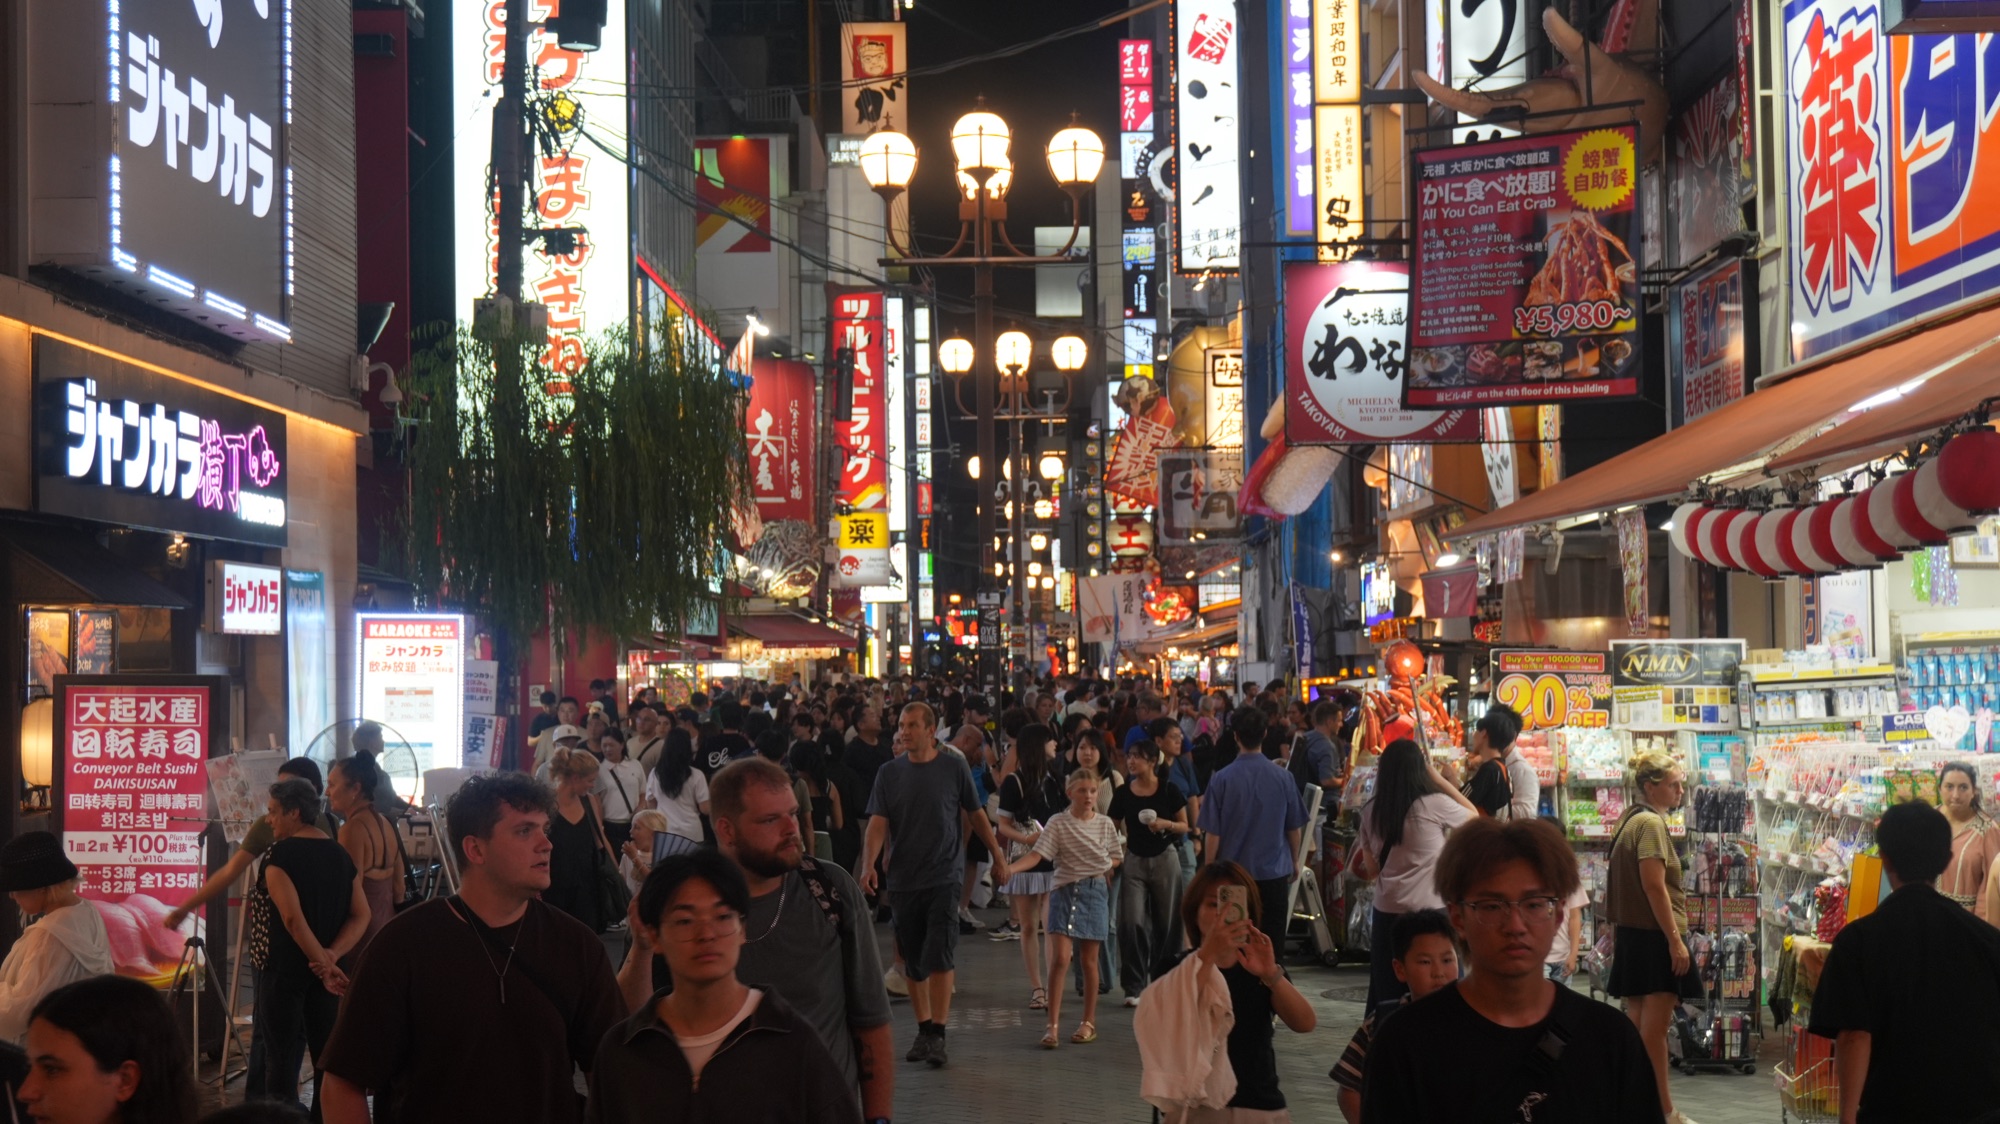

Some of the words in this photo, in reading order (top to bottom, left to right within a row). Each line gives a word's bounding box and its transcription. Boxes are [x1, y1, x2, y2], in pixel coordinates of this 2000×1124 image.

[128, 31, 274, 218] ジャンカラ
[1423, 164, 1445, 177] 元祖
[1450, 151, 1550, 174] 大阪かに食べ放題店
[1582, 147, 1620, 169] 螃蟹
[1800, 13, 1877, 296] 薬
[1423, 170, 1556, 206] かに食べ放題!
[1574, 168, 1628, 193] 自助餐
[1423, 208, 1437, 221] All
[1441, 207, 1465, 219] You
[1468, 203, 1494, 216] Can
[1497, 200, 1520, 213] Eat
[1523, 196, 1557, 210] Crab
[1471, 263, 1493, 271] Grilled
[1494, 260, 1524, 268] Seafood,
[1470, 278, 1524, 288] All-You-Can-Eat
[1477, 391, 1487, 399] on
[1489, 389, 1504, 398] the
[1505, 389, 1520, 397] 4th
[1521, 387, 1542, 396] floor
[1543, 385, 1554, 395] of
[1554, 385, 1572, 394] this
[1573, 383, 1610, 396] building
[1297, 391, 1347, 440] TAKOYAKI
[67, 378, 200, 500] ジャンカラ
[198, 419, 247, 512] 横丁
[849, 519, 875, 544] 薬
[226, 574, 278, 614] ジャンカラ
[369, 623, 432, 637] KARAOKE
[1505, 655, 1522, 664] Buy
[1524, 655, 1545, 663] Over
[1548, 655, 1581, 664] 100,000
[1624, 654, 1691, 672] NMN
[79, 696, 197, 723] 大起水産
[1497, 673, 1567, 731] 20
[1567, 712, 1608, 728] OFF
[1893, 714, 1925, 725] CAS
[72, 727, 201, 759] 回転寿司
[73, 762, 133, 776] Conveyor
[135, 763, 161, 774] Belt
[163, 763, 198, 774] Sushi
[94, 778, 177, 790] DAIKISUISAN
[69, 794, 132, 810] 回转寿司
[101, 812, 168, 829] 회전초밥
[113, 834, 168, 854] ¥100
